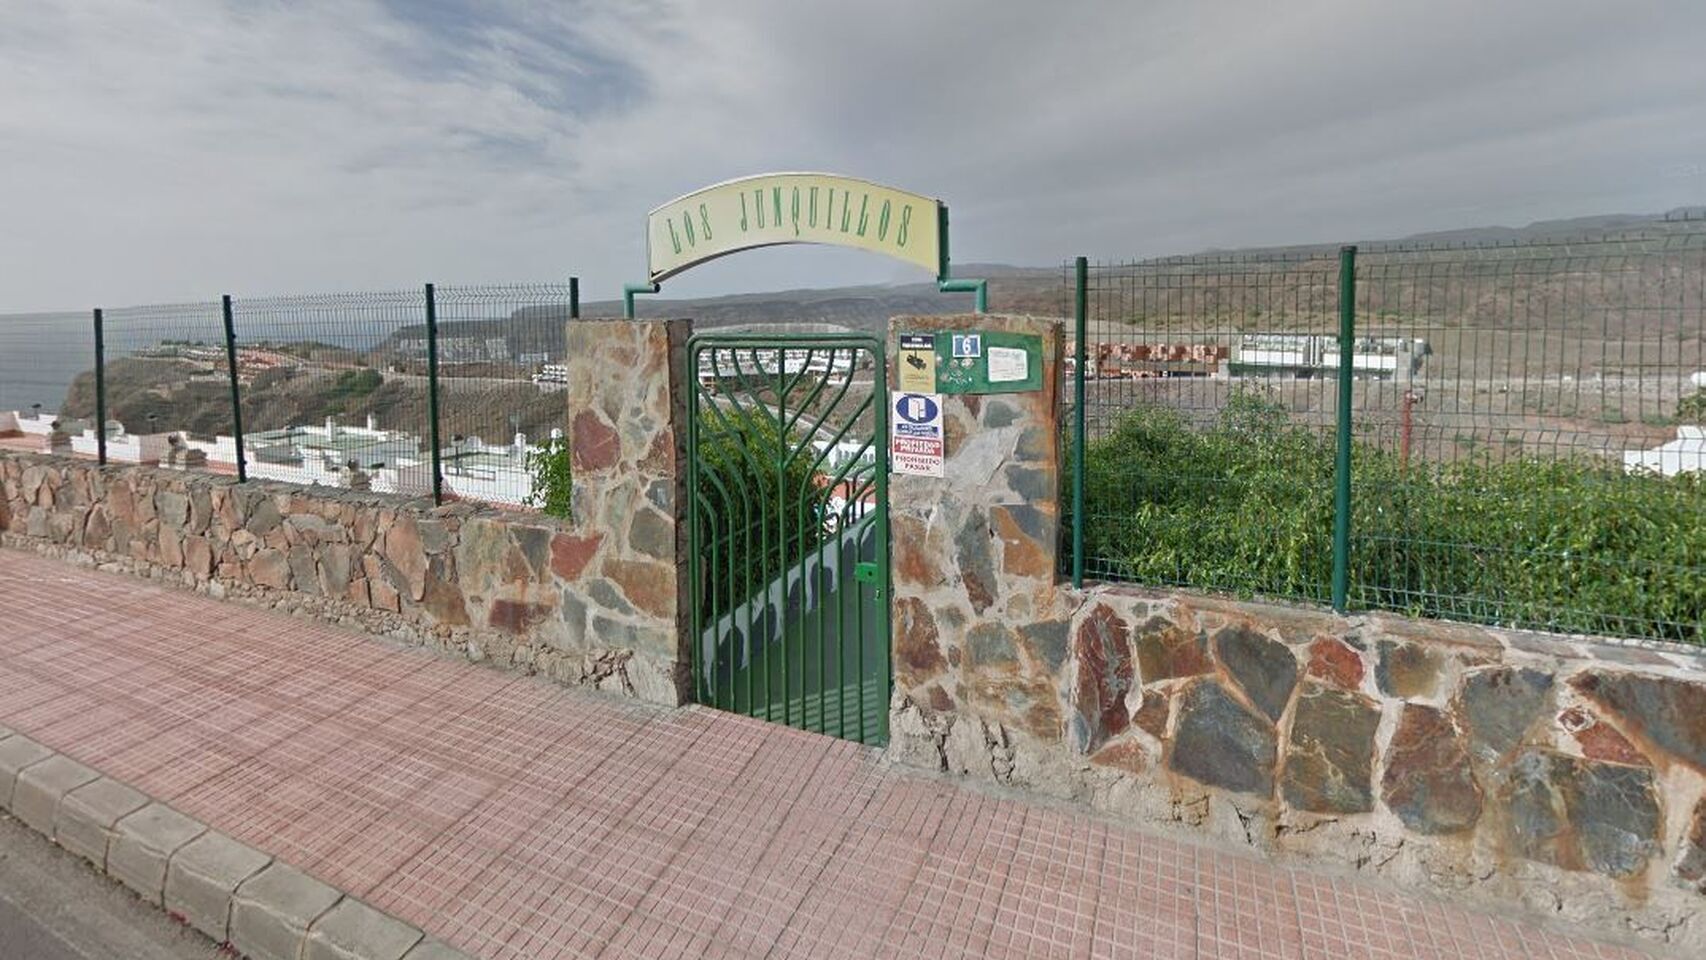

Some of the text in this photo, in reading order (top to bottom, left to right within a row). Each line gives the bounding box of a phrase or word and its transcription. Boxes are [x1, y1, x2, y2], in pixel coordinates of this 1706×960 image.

[667, 186, 913, 255] LOS JUNQUILLOS
[962, 338, 972, 354] 6
